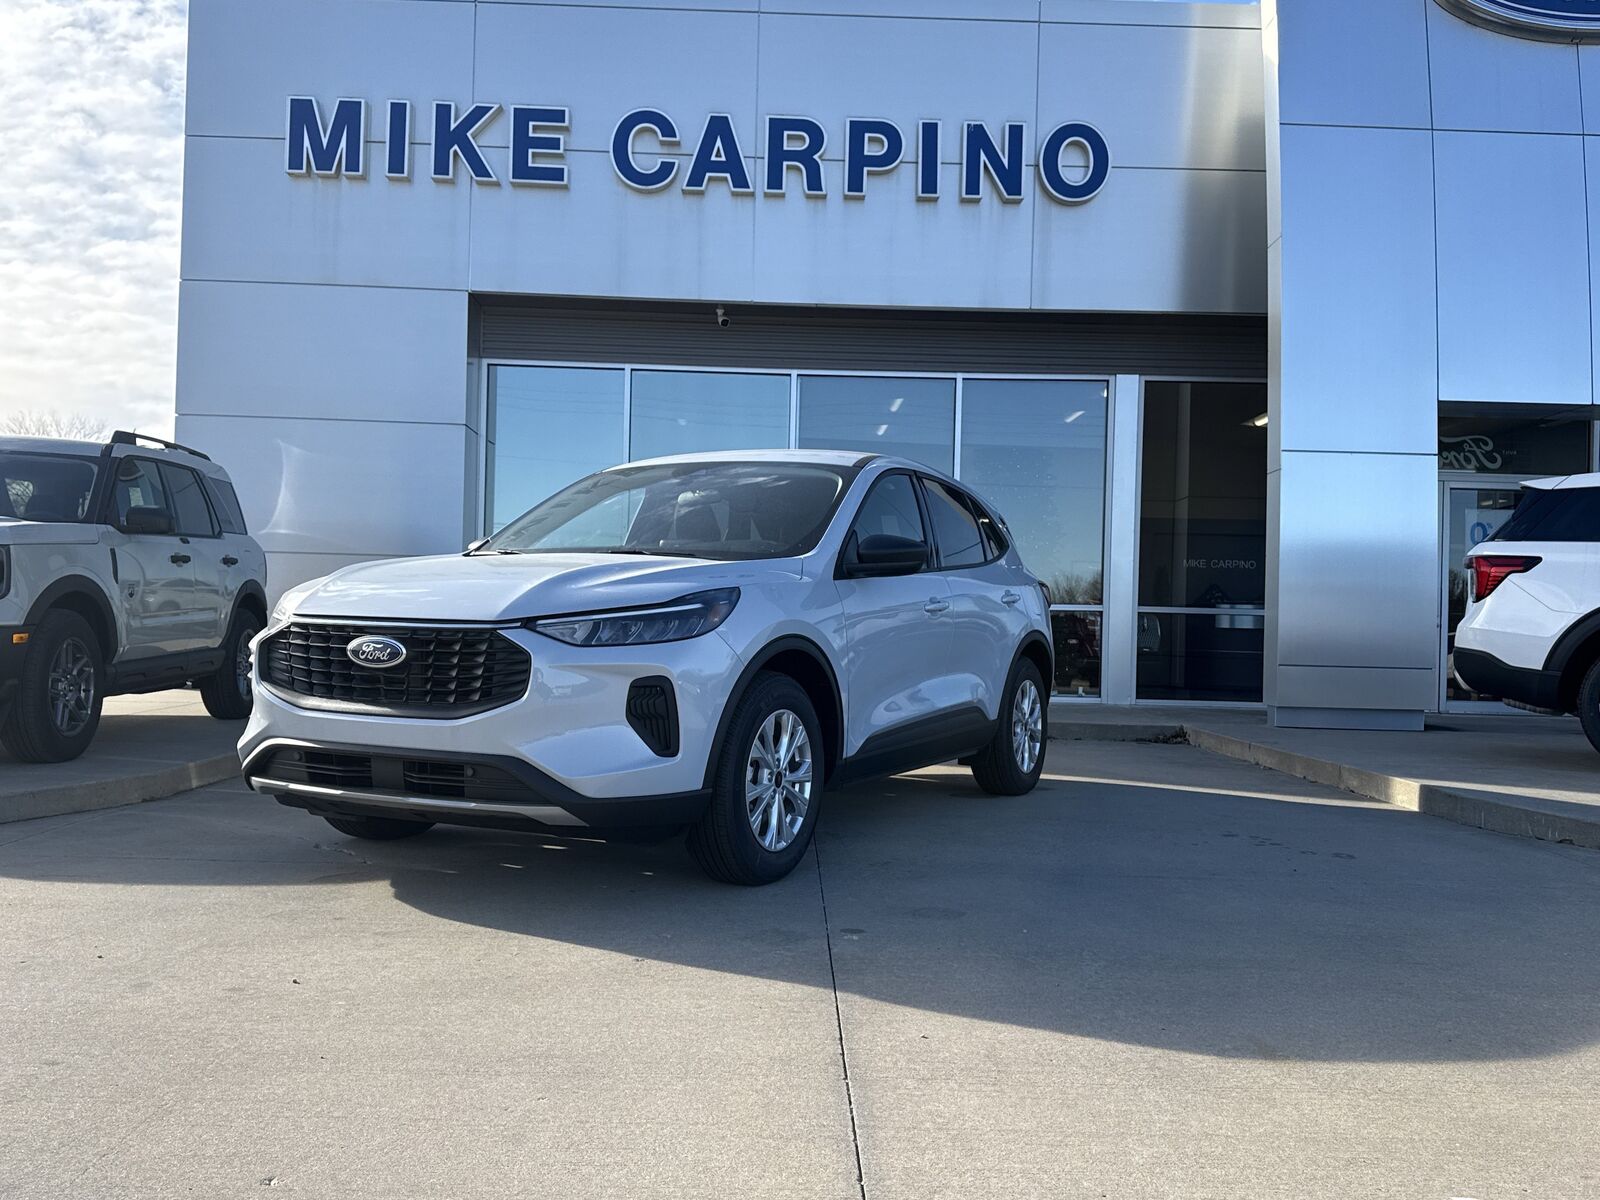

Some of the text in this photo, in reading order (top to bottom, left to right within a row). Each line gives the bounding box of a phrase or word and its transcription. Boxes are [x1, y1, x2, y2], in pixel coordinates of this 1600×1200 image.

[286, 96, 1111, 206] MIKE CARPINO
[1183, 559, 1257, 570] MIKE CARPINO
[359, 642, 391, 661] Ford
